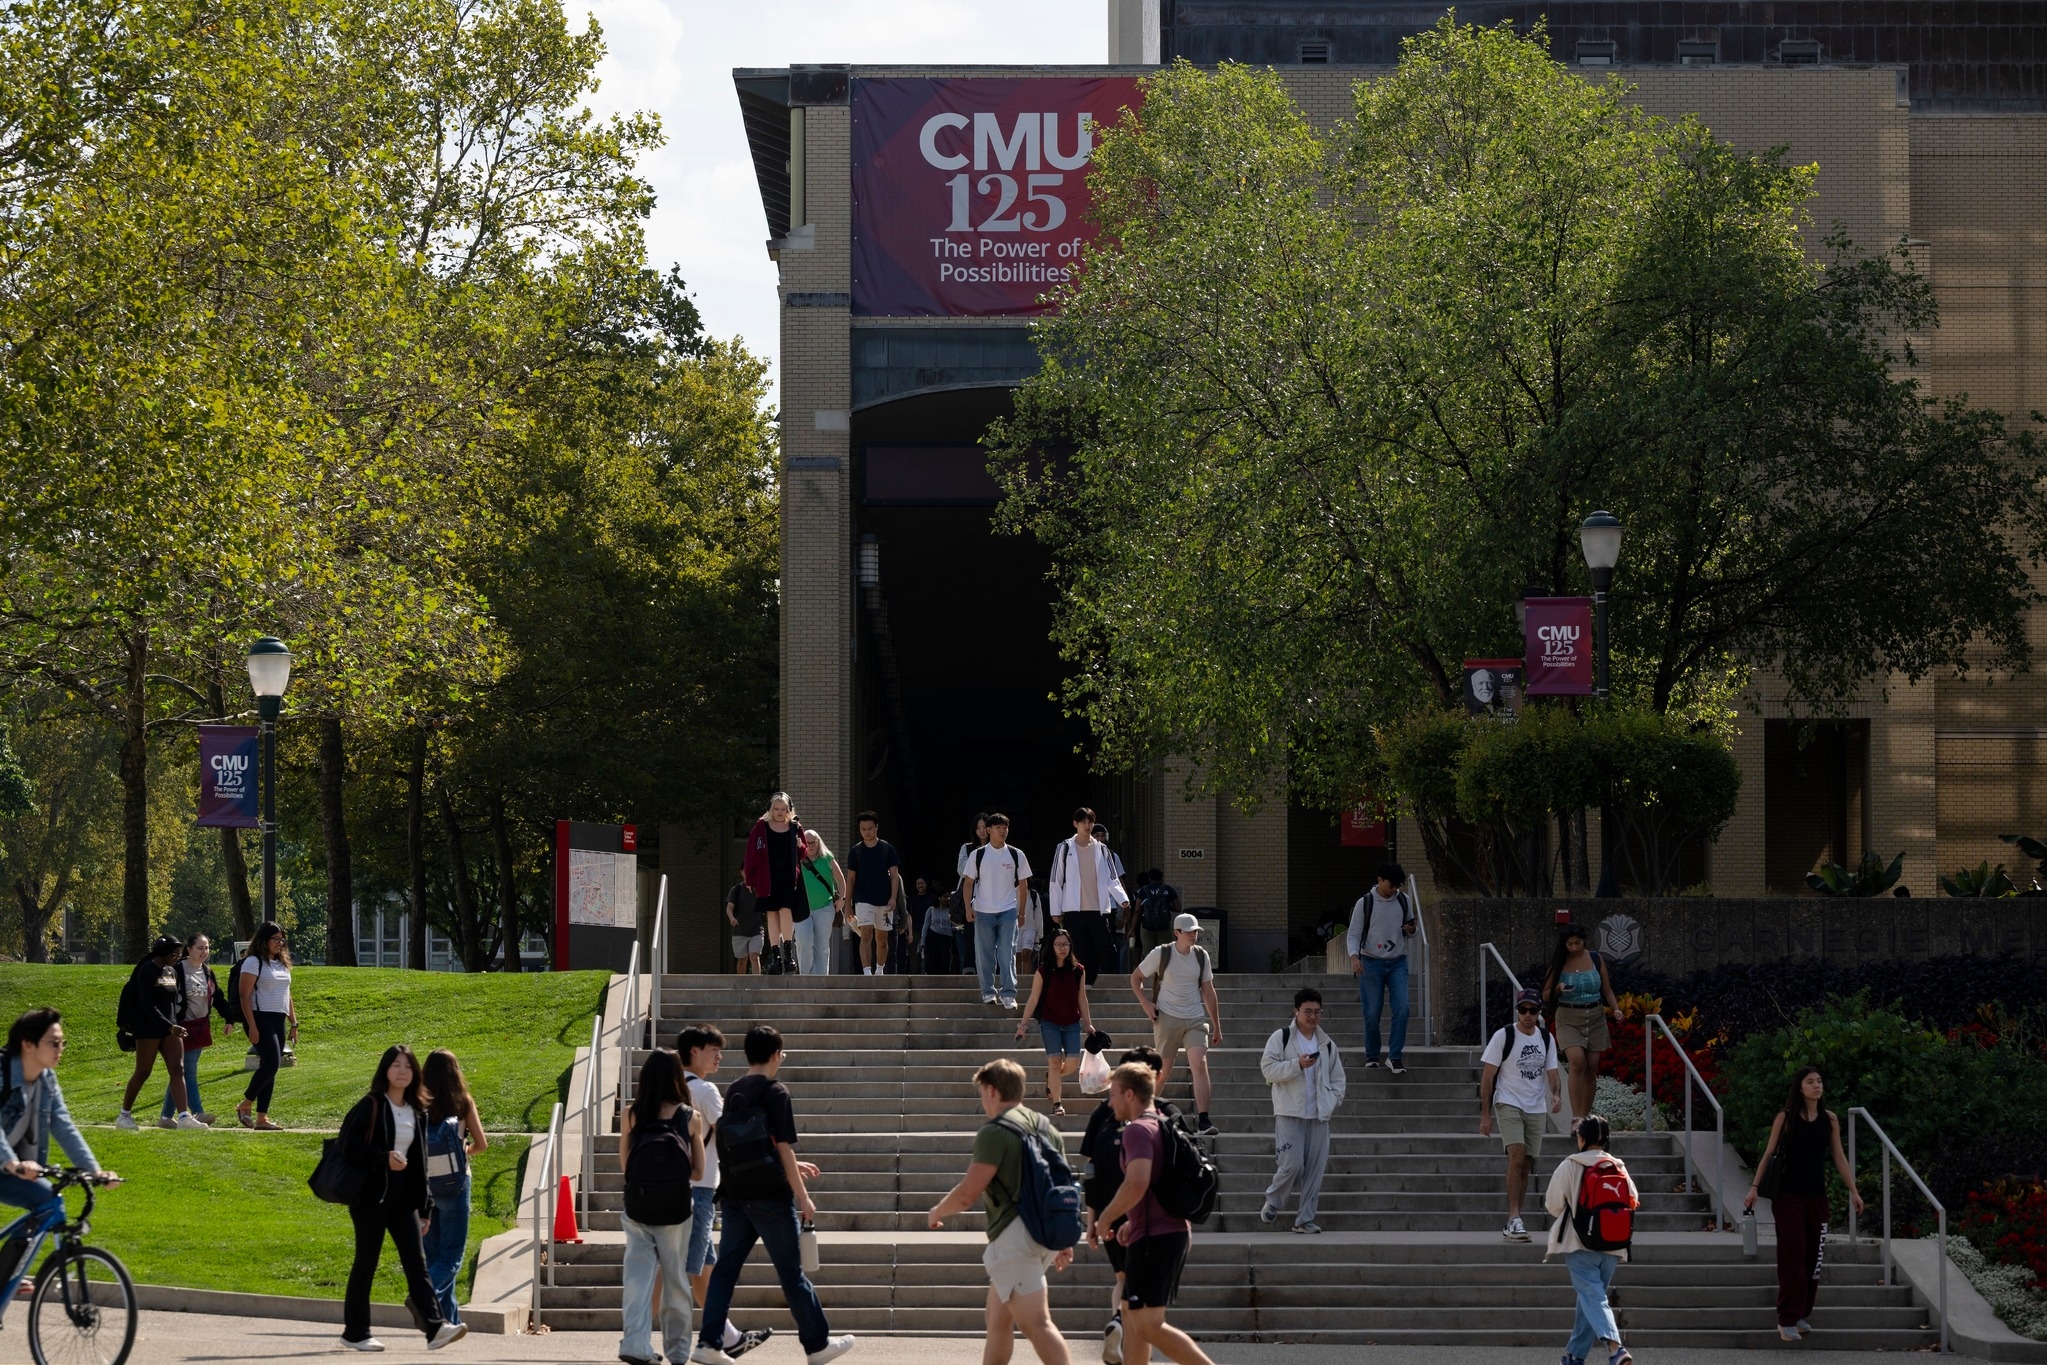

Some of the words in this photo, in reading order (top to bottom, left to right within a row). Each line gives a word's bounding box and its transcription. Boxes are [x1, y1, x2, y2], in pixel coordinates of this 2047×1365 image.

[919, 112, 1092, 171] CMU
[945, 173, 1067, 232] 125
[930, 238, 972, 258] The
[980, 238, 1050, 258] Power
[1057, 237, 1082, 258] of
[940, 262, 1070, 283] Possibilities
[1537, 625, 1579, 640] CMU
[1544, 640, 1574, 656] 125
[211, 755, 248, 770] CMU
[217, 770, 242, 785] 125
[1180, 850, 1202, 858] 5004
[1691, 926, 1929, 953] CARNEGIE
